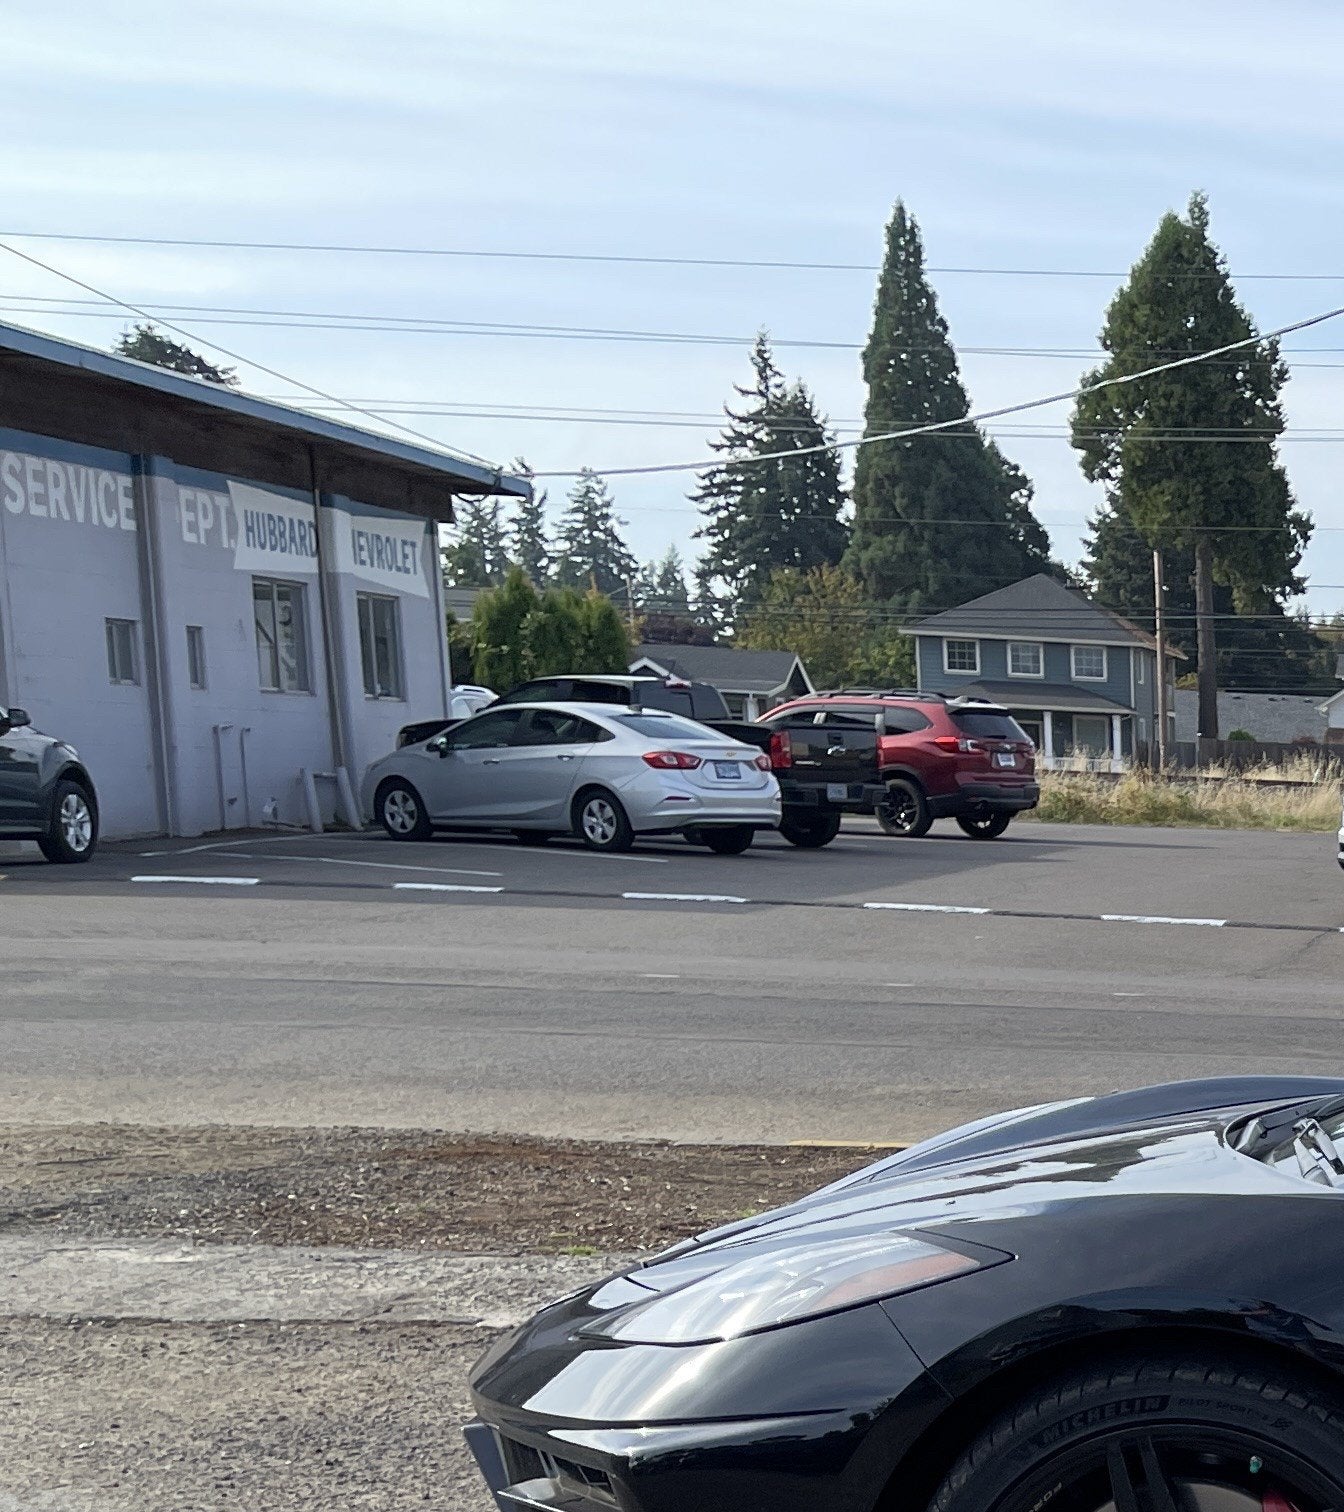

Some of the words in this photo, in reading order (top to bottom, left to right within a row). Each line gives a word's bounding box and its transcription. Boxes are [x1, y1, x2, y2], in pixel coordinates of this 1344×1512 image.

[1, 451, 138, 531] SERVICE
[178, 488, 237, 548] EPT.
[244, 509, 318, 557] HUBBARD
[352, 529, 418, 576] EVROLET
[1040, 1396, 1166, 1446] MICHELIN
